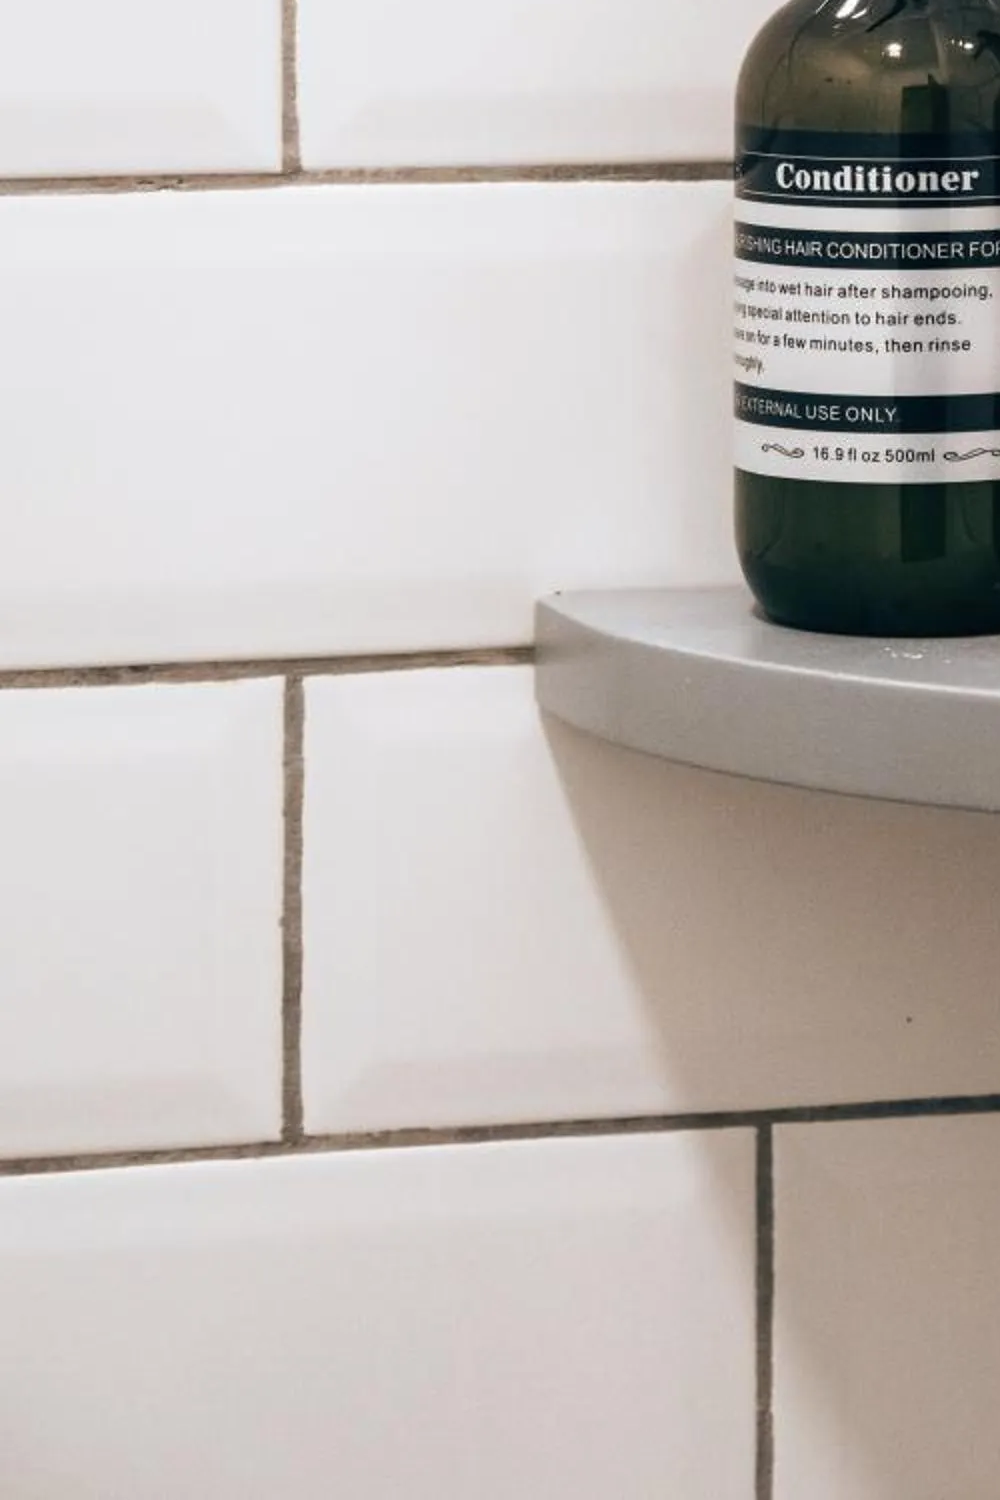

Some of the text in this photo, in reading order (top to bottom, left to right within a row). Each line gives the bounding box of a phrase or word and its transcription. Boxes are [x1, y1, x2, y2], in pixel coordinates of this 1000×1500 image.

[776, 162, 980, 194] Conditioner
[785, 239, 823, 257] HAIR
[826, 241, 963, 259] CONDITIONER
[779, 282, 801, 295] wet
[805, 282, 833, 298] hair
[838, 285, 876, 299] after
[881, 284, 993, 301] shampooing.
[785, 310, 850, 326] attention
[855, 311, 871, 326] to
[876, 310, 908, 326] hair
[773, 335, 780, 347] a
[783, 333, 806, 349] few
[809, 334, 879, 354] minutes,
[885, 336, 923, 352] then
[928, 336, 971, 351] rinse
[805, 405, 841, 421] USE
[813, 447, 935, 463] 16.9 fl oz 500ml
